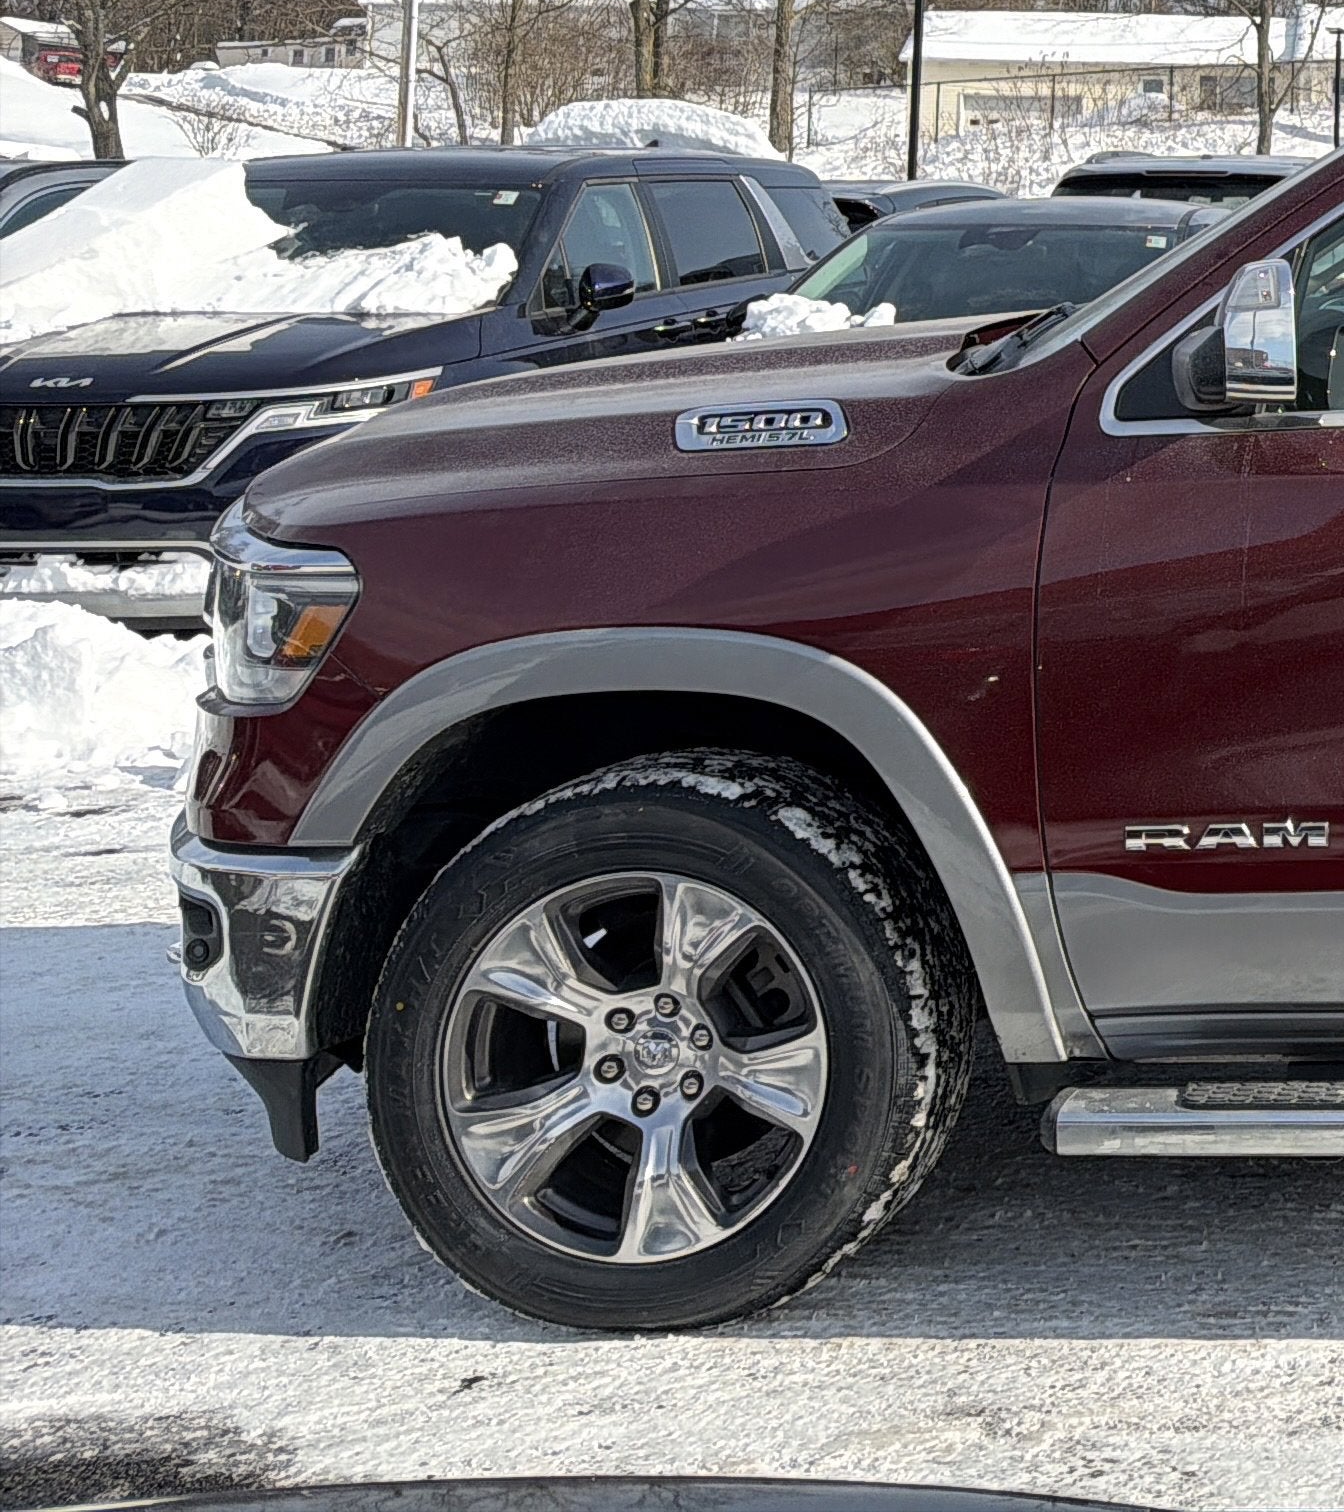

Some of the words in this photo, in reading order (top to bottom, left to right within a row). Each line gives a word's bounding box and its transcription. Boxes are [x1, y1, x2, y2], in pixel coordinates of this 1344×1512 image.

[702, 412, 823, 432] 1500
[711, 434, 760, 445] HEMI
[766, 431, 811, 443] 5.7L
[1125, 818, 1329, 851] RAM
